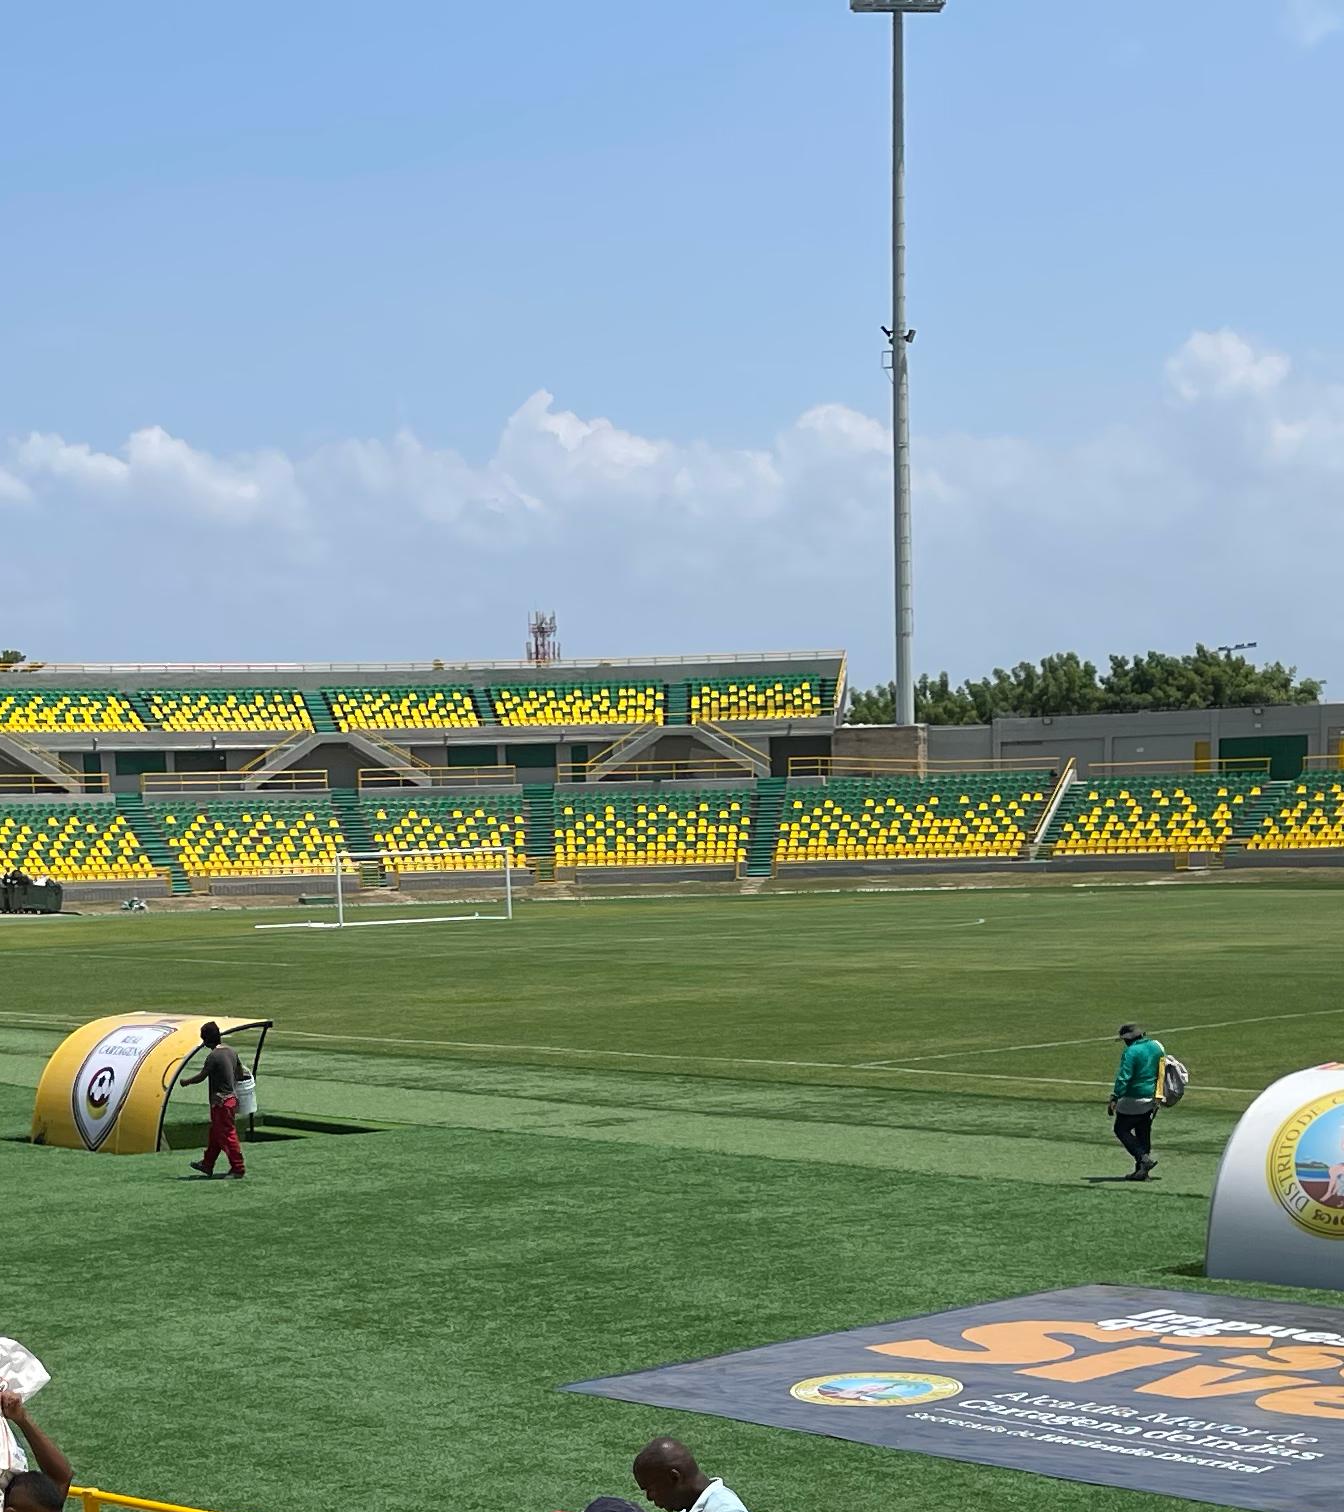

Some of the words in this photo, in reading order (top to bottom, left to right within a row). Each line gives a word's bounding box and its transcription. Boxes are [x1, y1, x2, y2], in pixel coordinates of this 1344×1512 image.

[1276, 1128, 1307, 1214] DISTRITO
[1296, 1107, 1323, 1127] DE
[1137, 1412, 1270, 1438] Mayor
[1266, 1432, 1319, 1445] de
[1142, 1429, 1195, 1443] de
